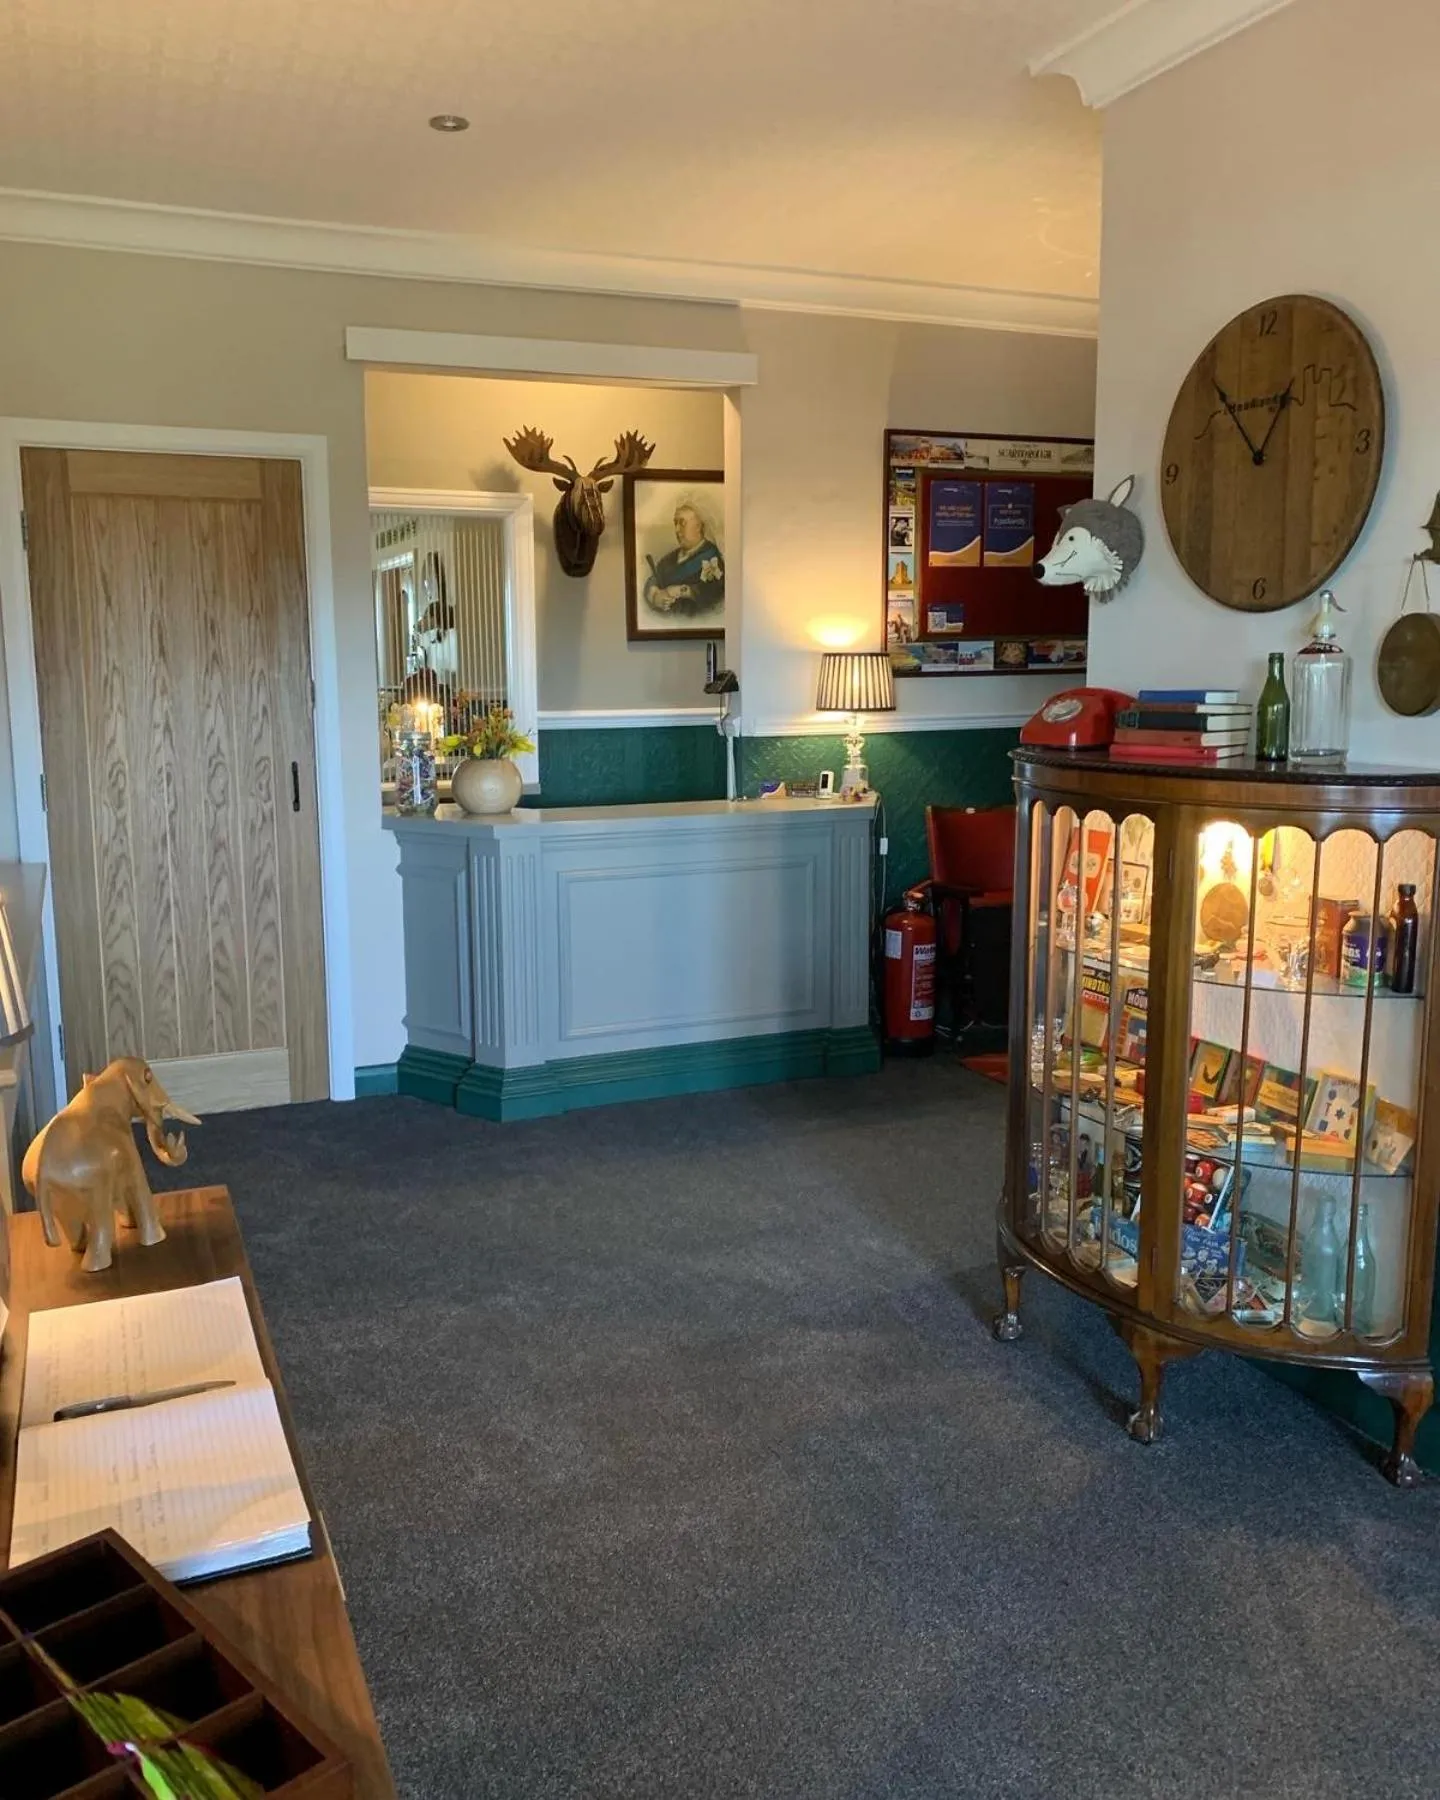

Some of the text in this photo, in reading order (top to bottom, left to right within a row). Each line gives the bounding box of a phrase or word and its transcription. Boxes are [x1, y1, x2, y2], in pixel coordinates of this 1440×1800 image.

[1258, 310, 1279, 337] 12
[1354, 427, 1371, 456] 3
[1165, 463, 1180, 485] 9
[1252, 577, 1268, 600] 6
